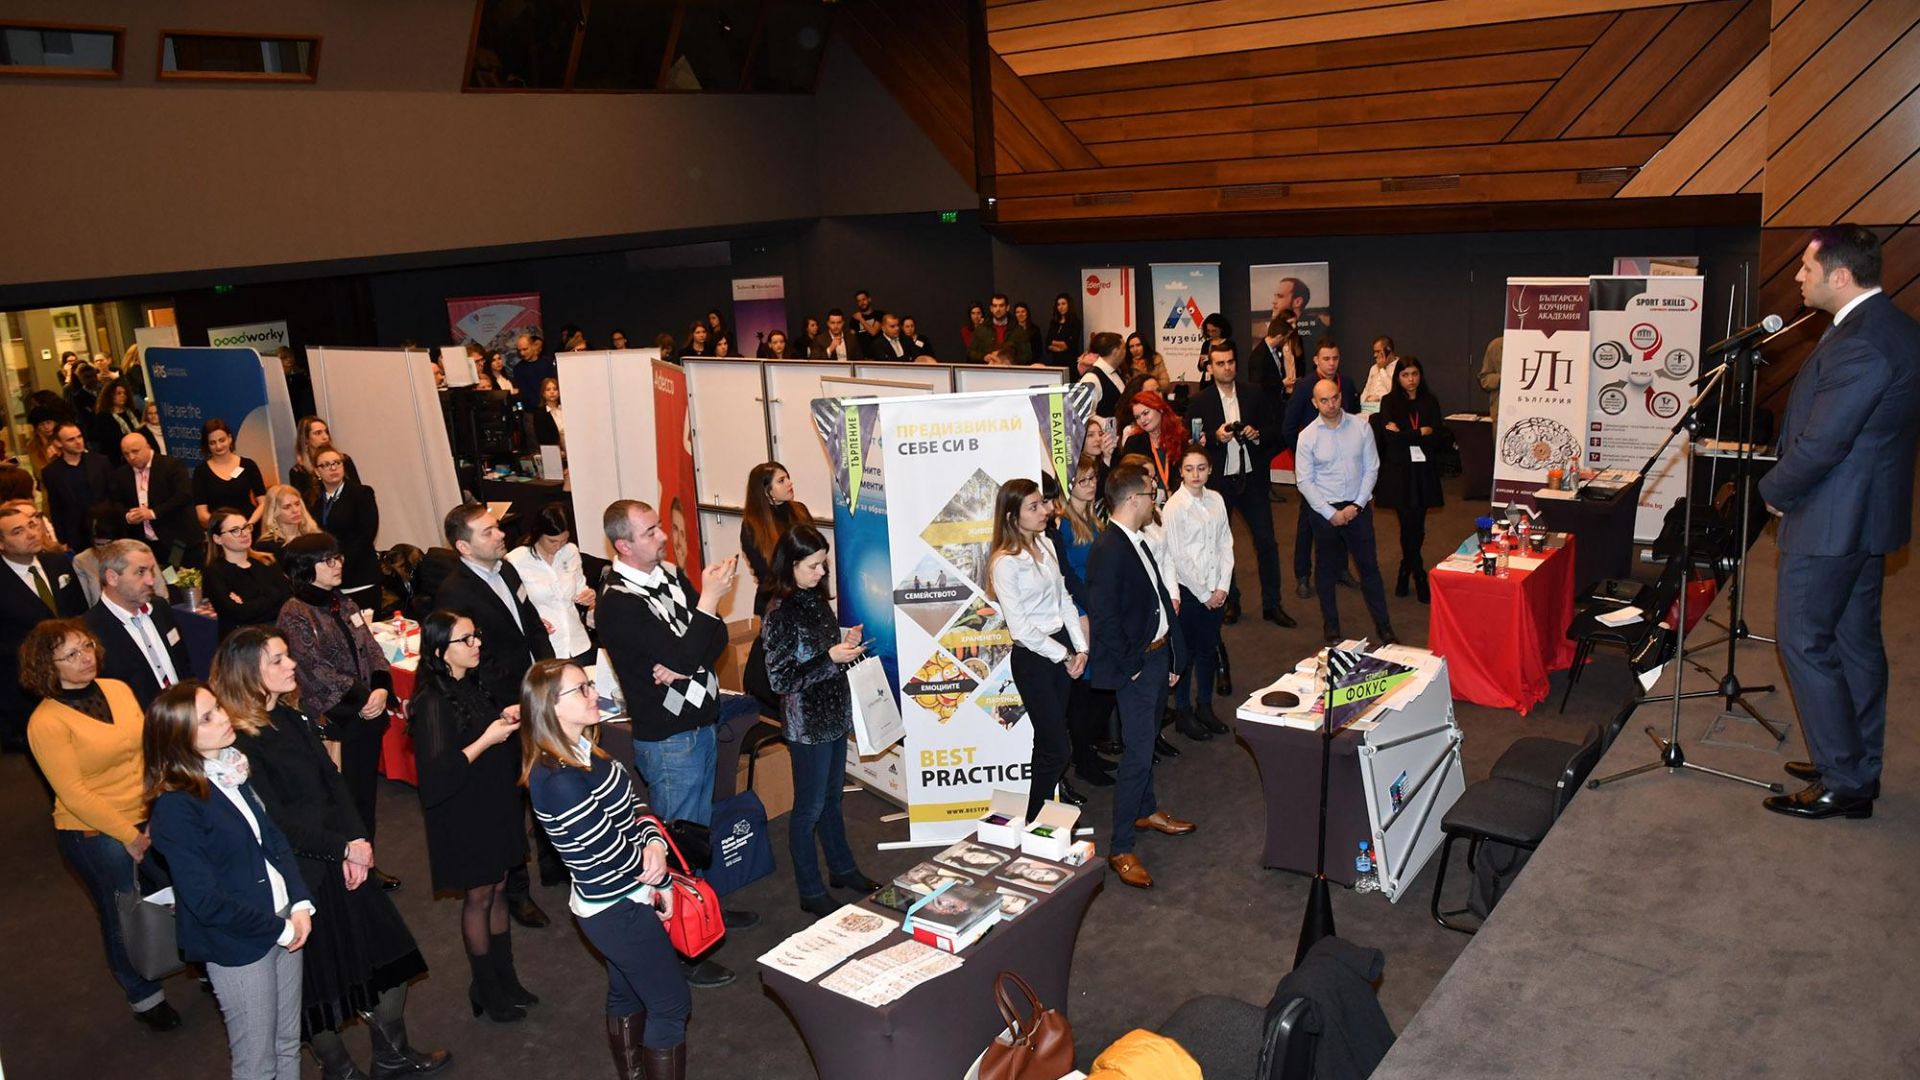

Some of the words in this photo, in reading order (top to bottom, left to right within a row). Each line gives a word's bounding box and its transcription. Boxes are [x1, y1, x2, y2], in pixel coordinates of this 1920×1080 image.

[1538, 294, 1583, 302] БЪЛГАРСКА
[1636, 298, 1659, 307] SPORT
[1662, 298, 1686, 307] SKILLS
[1538, 303, 1576, 311] КОУЧИНГ
[1537, 312, 1581, 320] АКАДЕМИЯ
[1517, 396, 1572, 404] БЪЛГАРИЯ
[896, 416, 1022, 437] ПРЕДИЗВИКАЙ
[848, 416, 860, 468] ТЪРПЕНИЕ
[1052, 412, 1065, 465] БАЛАНС
[898, 441, 938, 455] СЕБЕ
[942, 439, 965, 452] СИ
[904, 590, 957, 600] СЕМЕЙСТВОТО
[920, 682, 960, 693] ЕМОЦИИТЕ
[1346, 679, 1388, 701] ФОКУС
[920, 747, 977, 767] BEST
[921, 763, 1032, 787] PRACTICE
